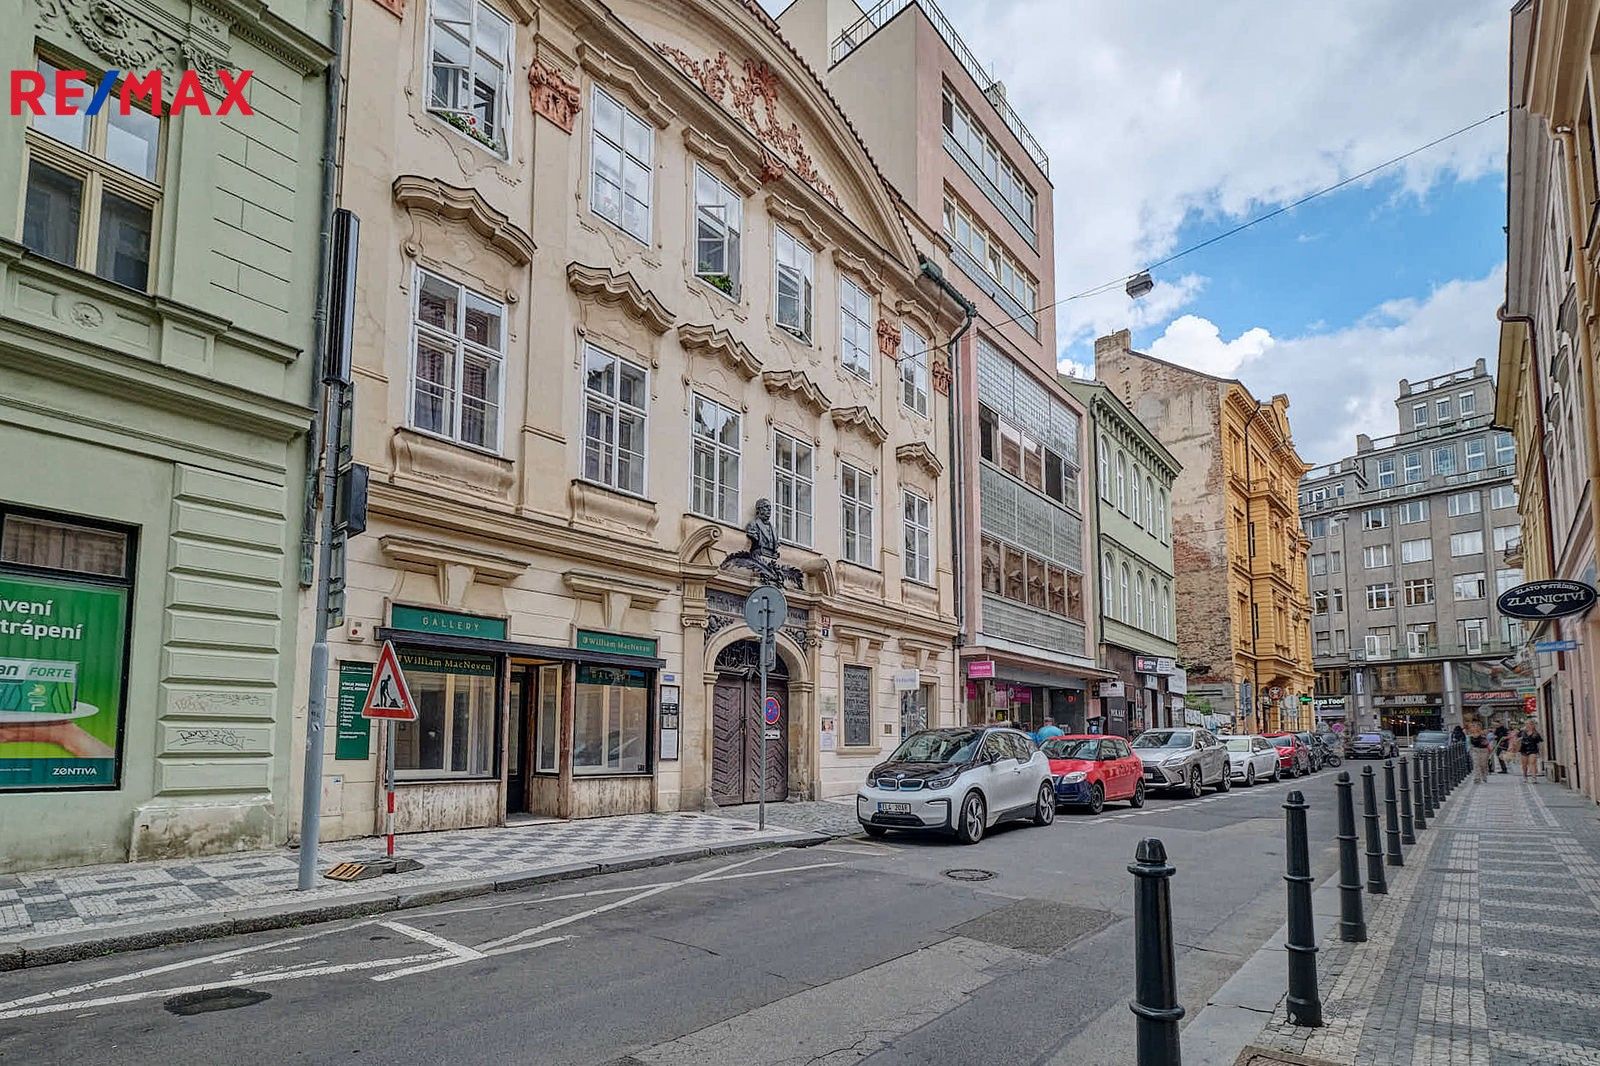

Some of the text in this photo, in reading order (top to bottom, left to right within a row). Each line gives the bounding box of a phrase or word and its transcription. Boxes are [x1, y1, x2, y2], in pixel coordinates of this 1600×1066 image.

[1515, 585, 1540, 594] ZLATO
[1507, 590, 1586, 606] ZLATNICTVÍ
[422, 616, 480, 631] GALLERY
[589, 637, 616, 648] William
[403, 655, 491, 671] William MacNeven
[28, 667, 73, 679] FORTE
[52, 767, 97, 776] ZENTIVA
